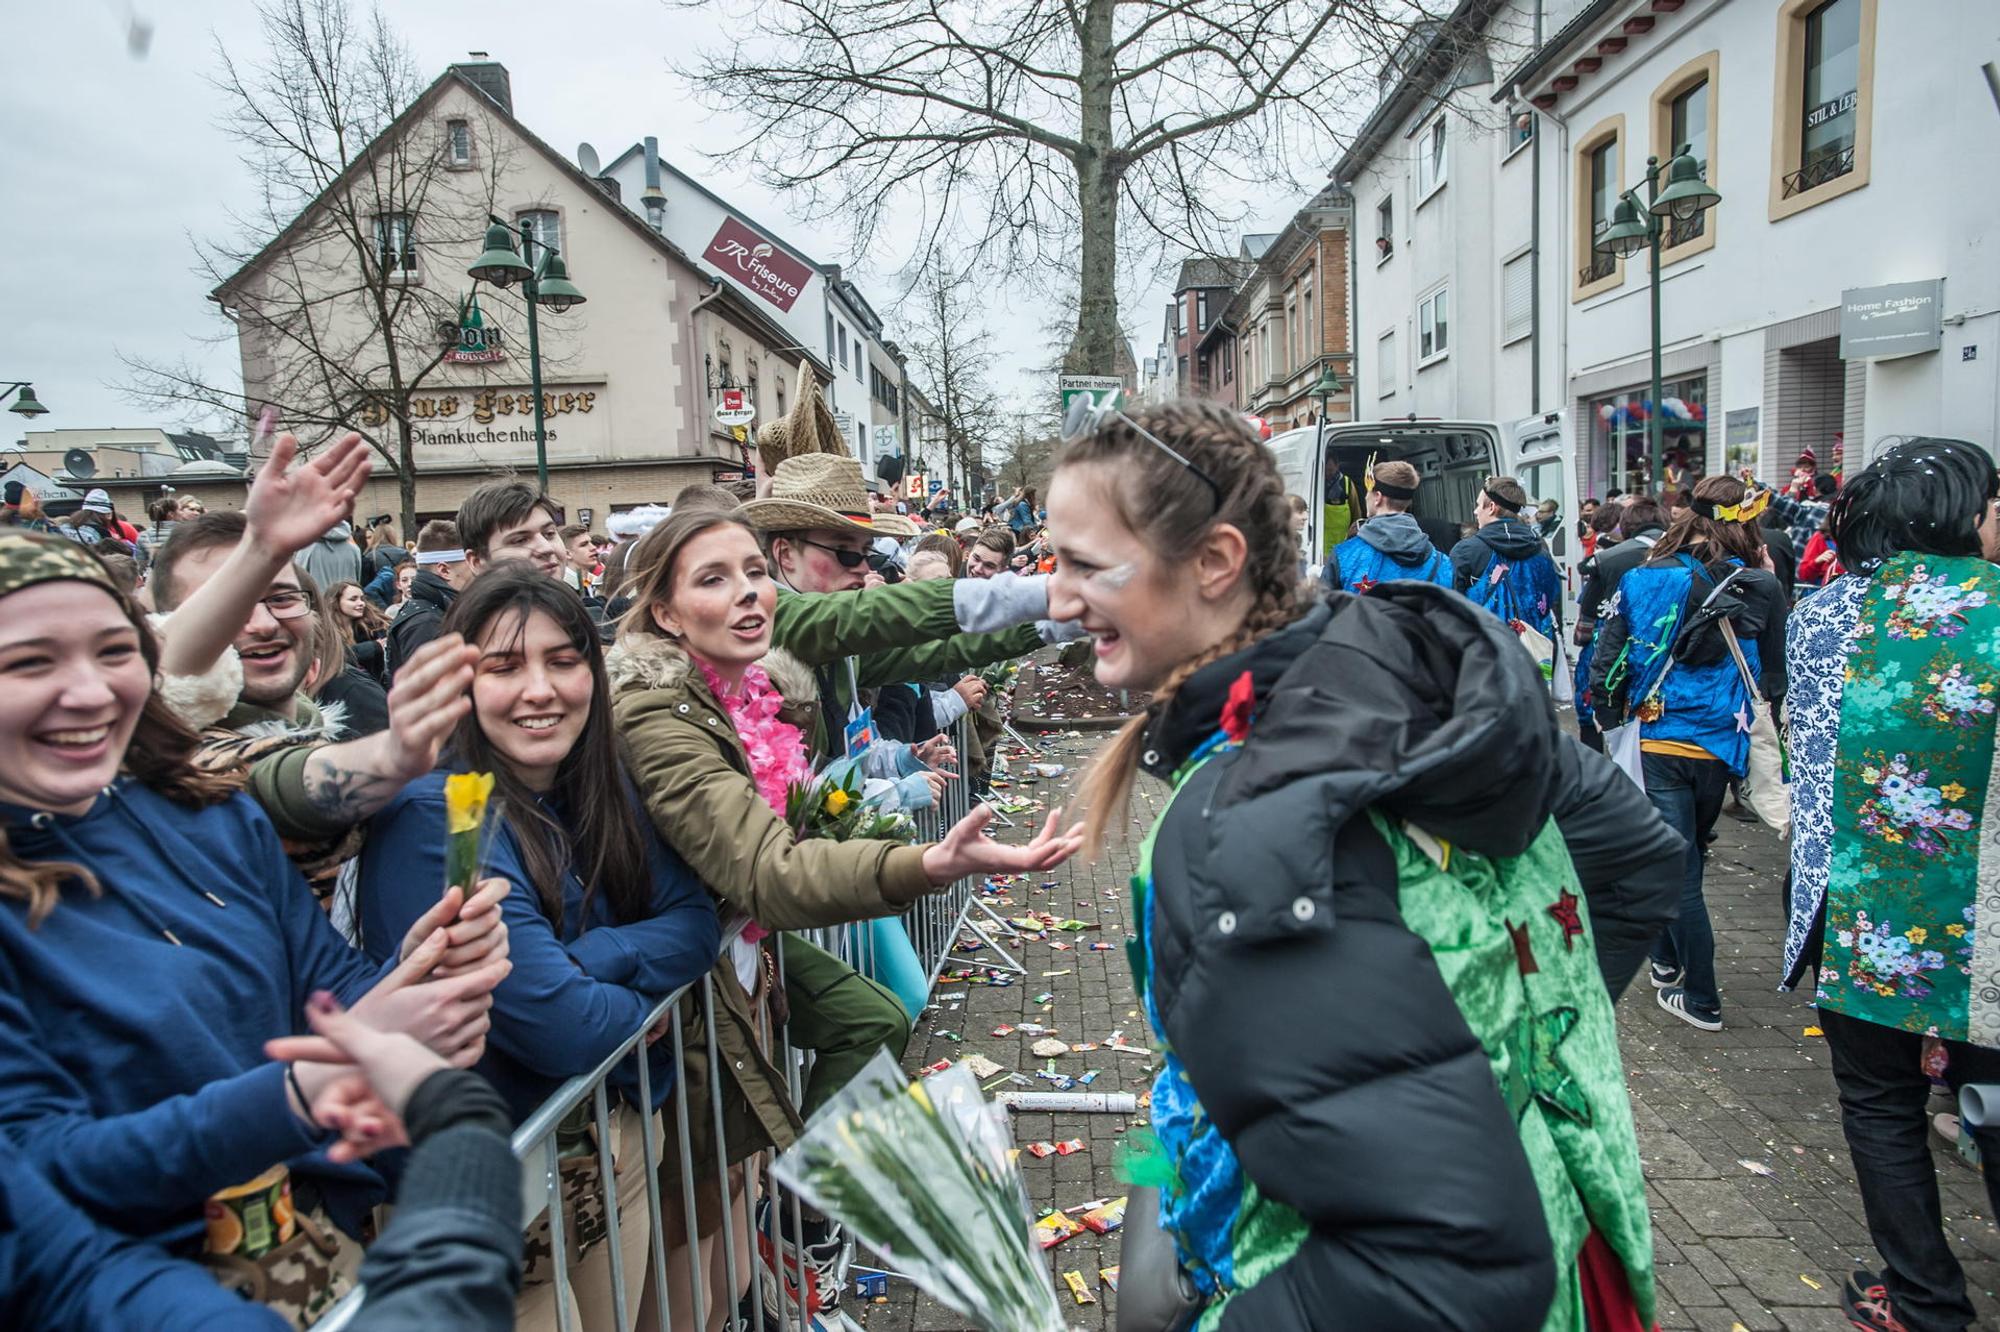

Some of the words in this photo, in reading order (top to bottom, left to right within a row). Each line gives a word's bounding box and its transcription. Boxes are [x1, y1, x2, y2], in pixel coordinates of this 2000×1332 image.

[1808, 107, 1828, 128] STIL
[1829, 102, 1837, 117] &
[713, 240, 748, 271] JR
[747, 258, 798, 298] Friseure
[1847, 303, 1882, 313] Home
[1885, 296, 1932, 309] Fashion
[440, 321, 501, 349] Dom
[1062, 379, 1092, 388] Partner
[1093, 380, 1121, 389] nehmen
